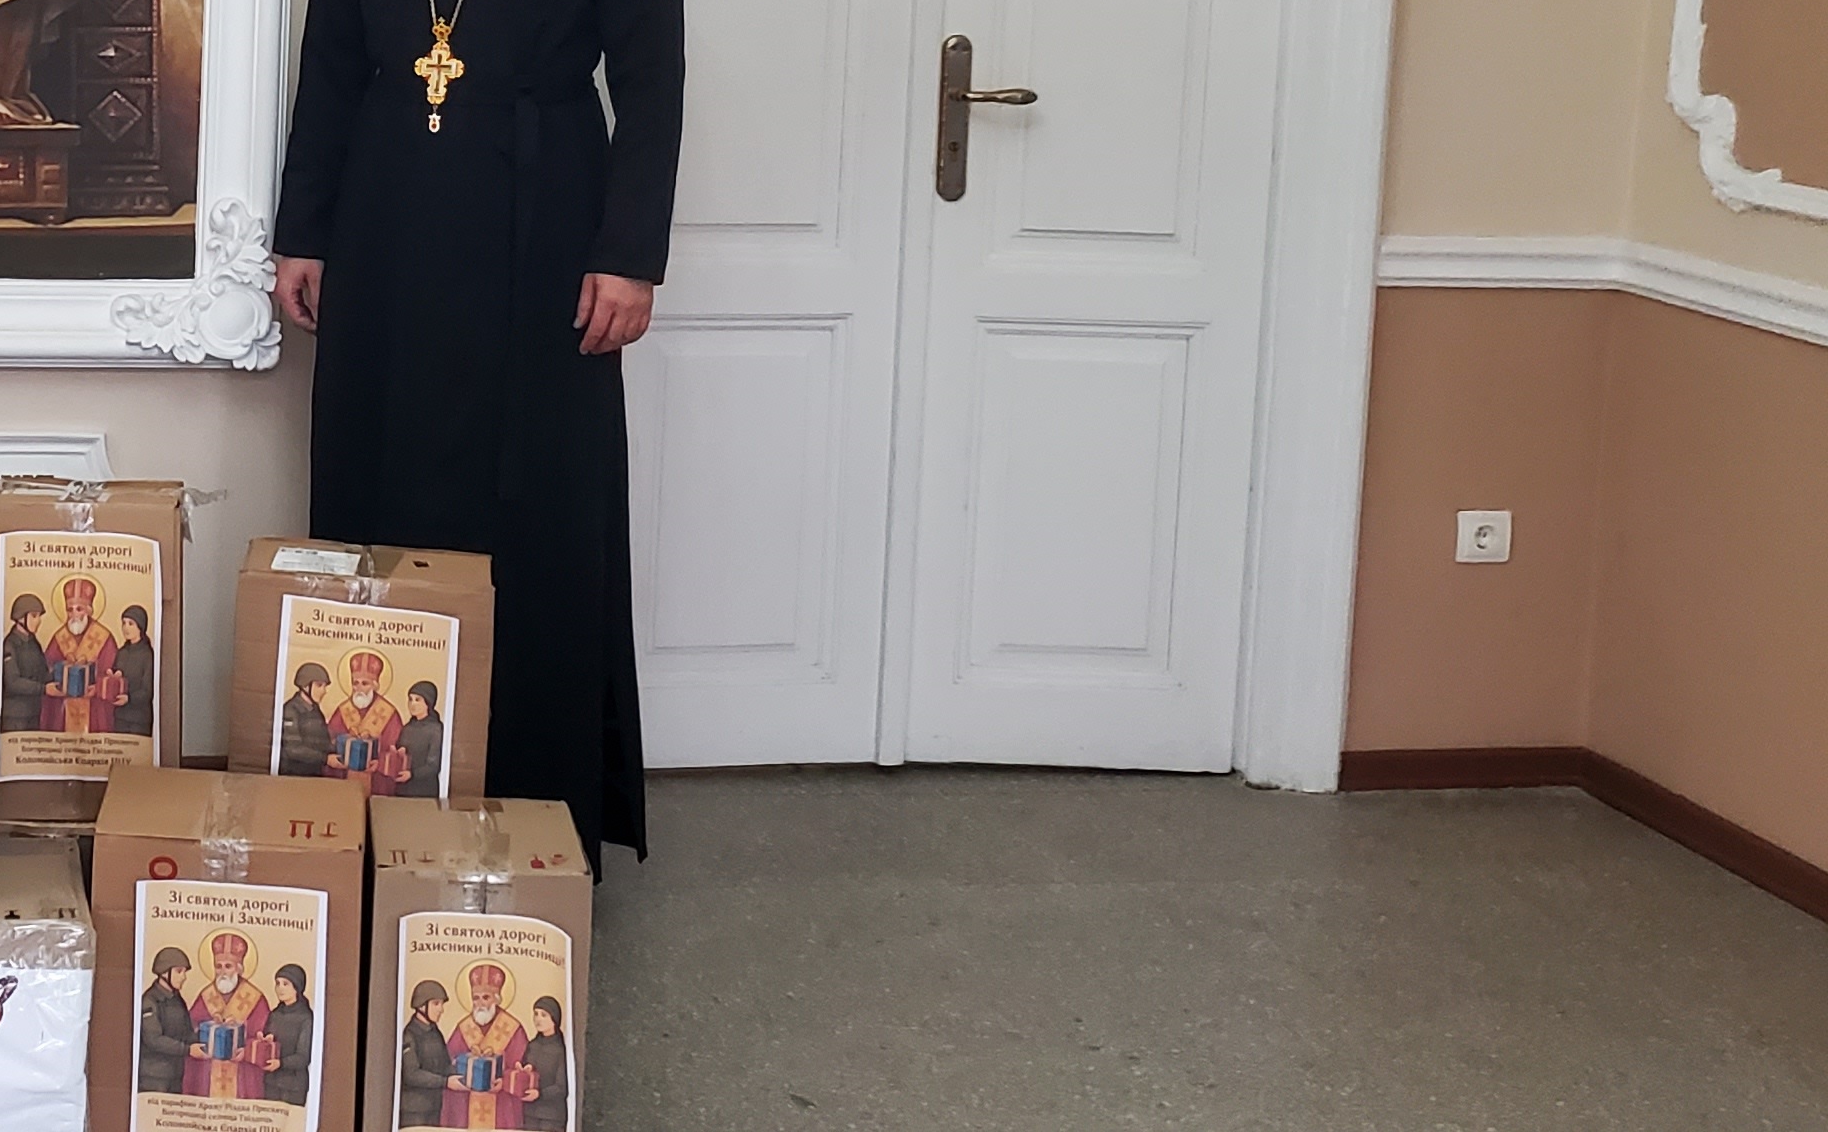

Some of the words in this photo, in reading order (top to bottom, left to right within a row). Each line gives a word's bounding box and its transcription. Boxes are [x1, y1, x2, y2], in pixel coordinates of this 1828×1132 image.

[23, 541, 35, 553] Зі
[39, 543, 86, 555] святом
[90, 544, 132, 558] дорогі
[9, 557, 75, 569] Захисники
[86, 558, 152, 575] Захисниці!
[312, 609, 324, 623] Зі
[328, 614, 375, 629] святом
[378, 621, 424, 634] дорогі
[295, 622, 363, 643] Захисники
[375, 633, 446, 651] Захисниці!
[169, 890, 182, 904] Зі
[186, 893, 238, 909] святом
[241, 896, 290, 914] дорогі
[151, 906, 225, 923] Захисники
[238, 912, 314, 932] Захисниці!
[425, 923, 439, 936] Зі
[443, 925, 495, 939] святом
[499, 930, 547, 945] дорогі
[410, 940, 483, 954] Захисники
